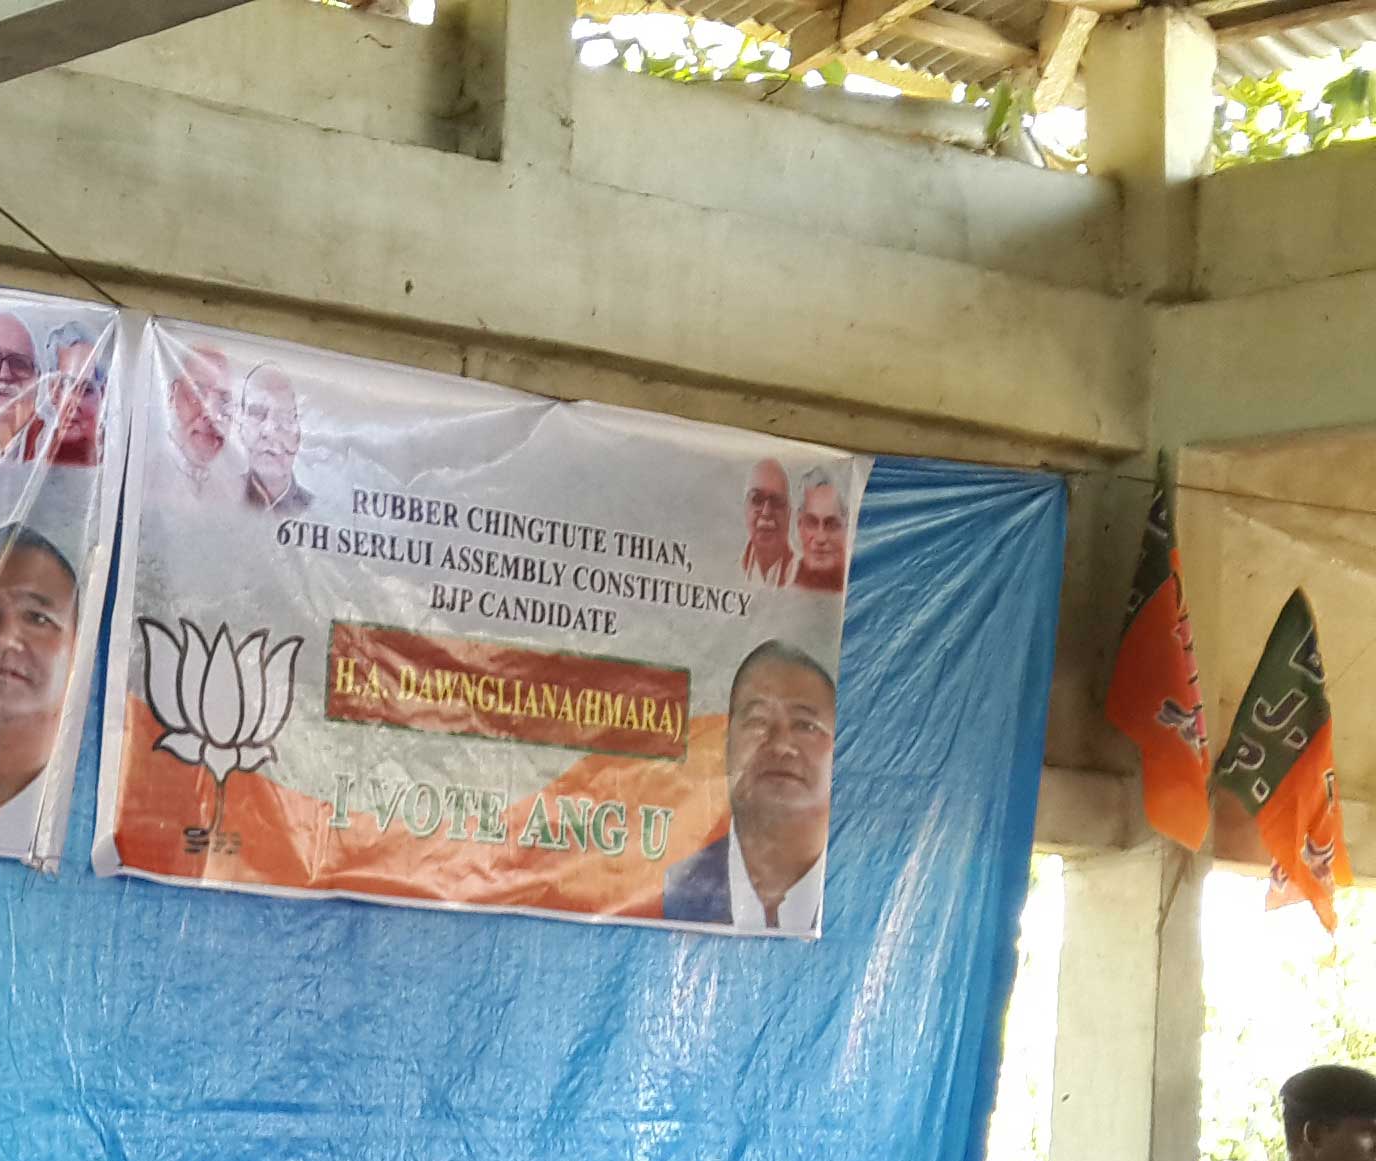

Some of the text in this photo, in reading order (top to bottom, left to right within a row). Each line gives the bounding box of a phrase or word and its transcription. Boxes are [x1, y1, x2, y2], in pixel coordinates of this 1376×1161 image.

[277, 520, 752, 617] 6TH SERLUI ASSEMBLY CONSTITUENCY
[351, 489, 693, 572] RUBBER CHINGTUTE THIAN,
[430, 584, 618, 636] BJP CANDIDATE
[334, 659, 682, 742] H.A. DAWNGLIANA(HMARA)
[330, 773, 673, 859] I VOTE ANG U
